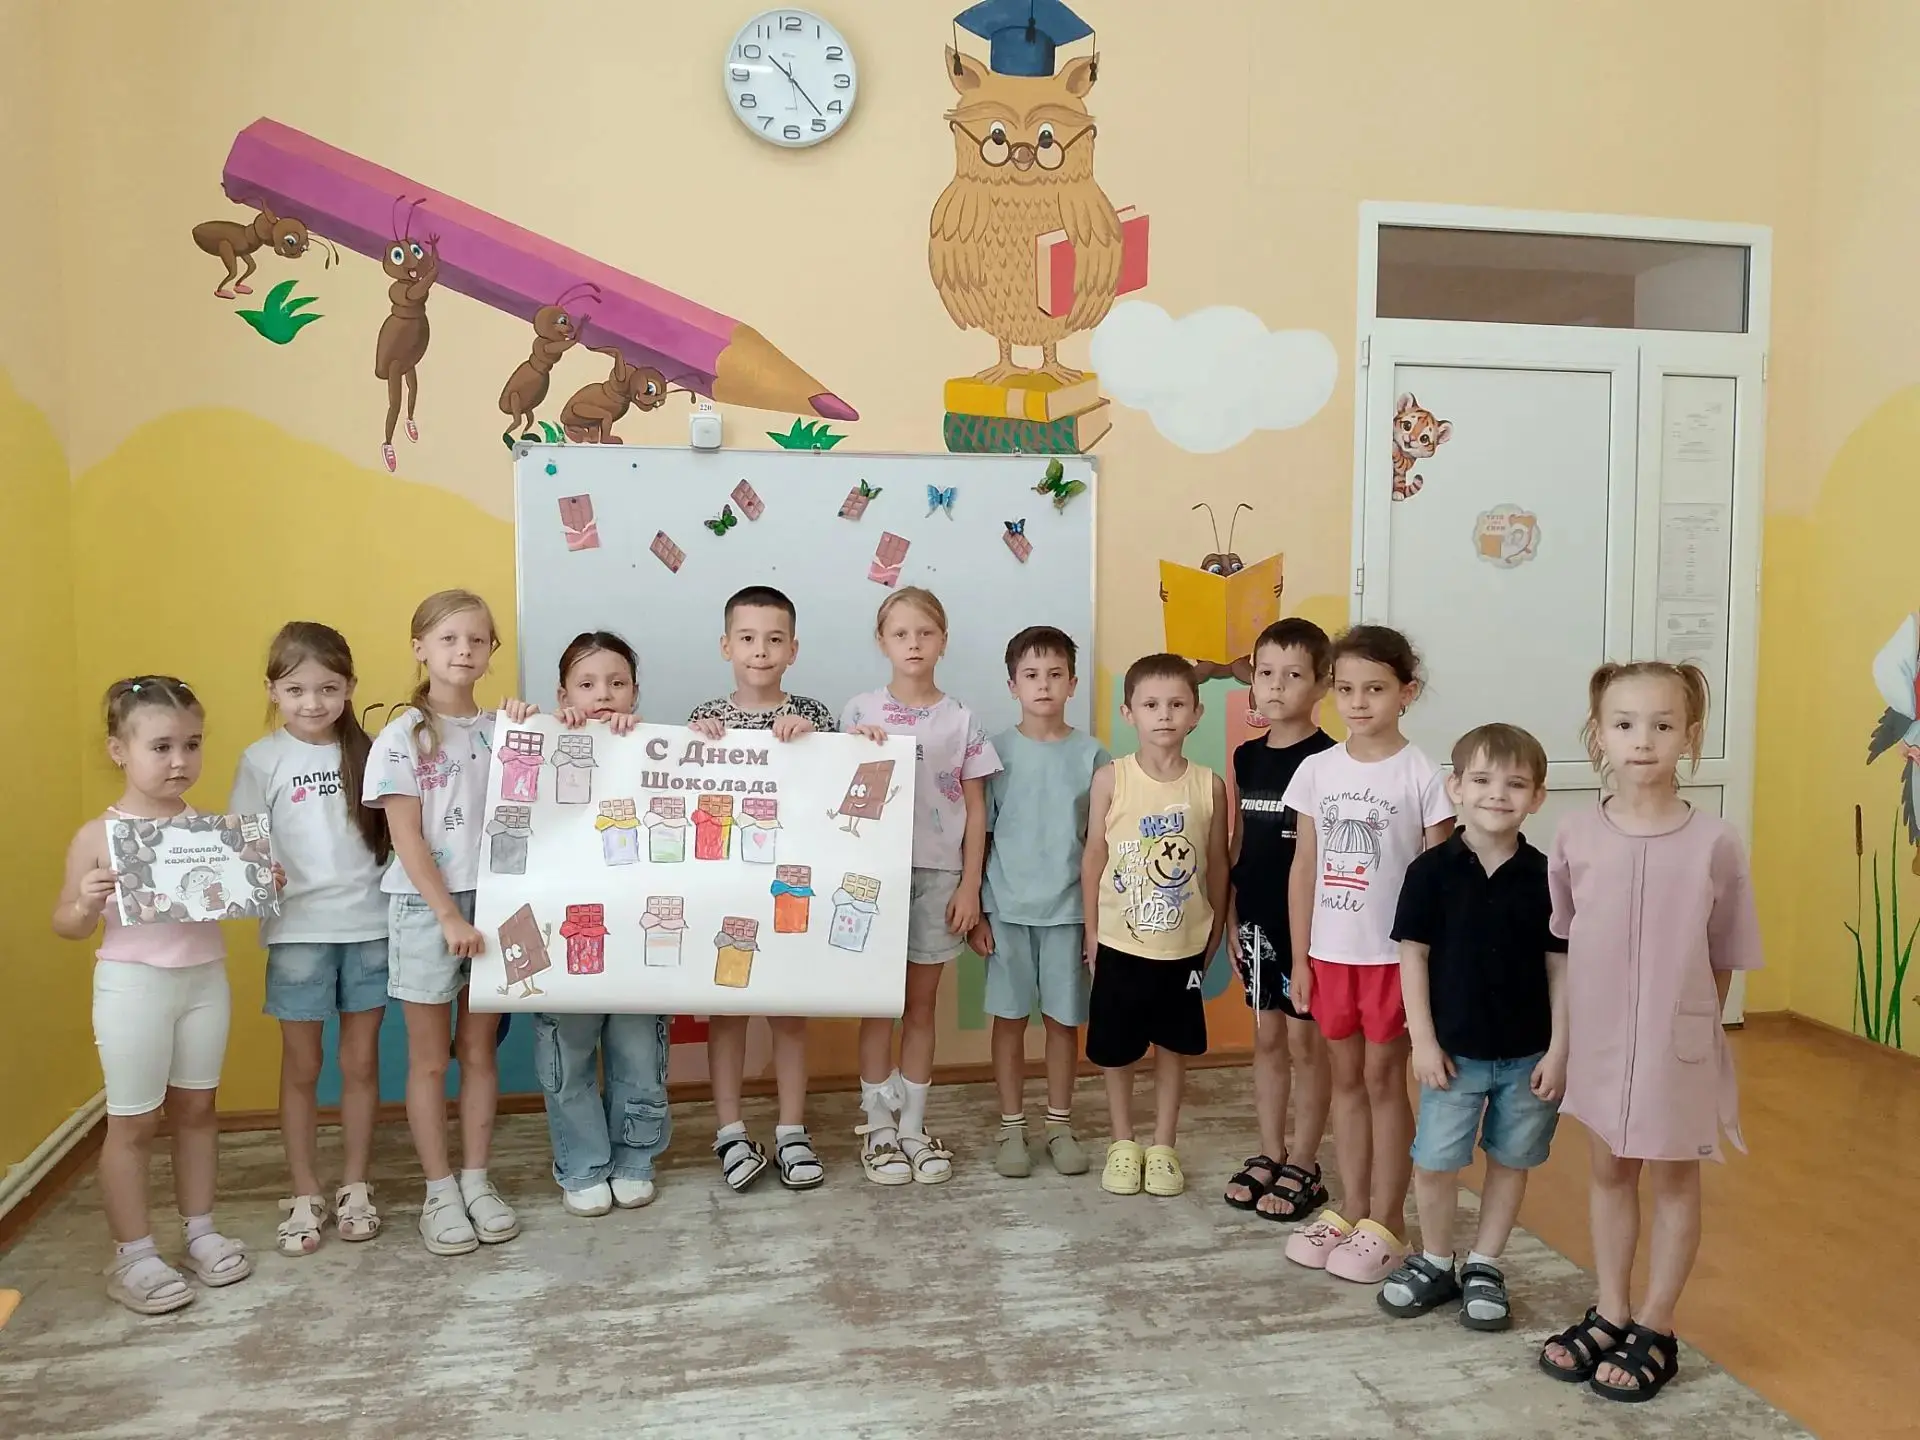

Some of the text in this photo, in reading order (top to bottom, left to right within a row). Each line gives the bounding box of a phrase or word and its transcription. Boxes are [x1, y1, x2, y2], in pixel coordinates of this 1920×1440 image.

[779, 16, 802, 31] 12
[758, 24, 770, 40] 11
[738, 44, 761, 59] 10
[826, 46, 843, 61] 2
[732, 67, 750, 82] 9
[833, 74, 851, 89] 3
[740, 93, 757, 108] 8
[827, 99, 843, 114] 4
[757, 115, 775, 130] 7
[811, 119, 826, 132] 5
[783, 125, 801, 140] 6
[645, 738, 769, 767] С Днем
[292, 770, 341, 787] ПАПИН
[641, 770, 778, 794] Шоколада
[1380, 799, 1399, 815] me
[1139, 812, 1185, 838] HEY
[164, 855, 206, 865] каждый
